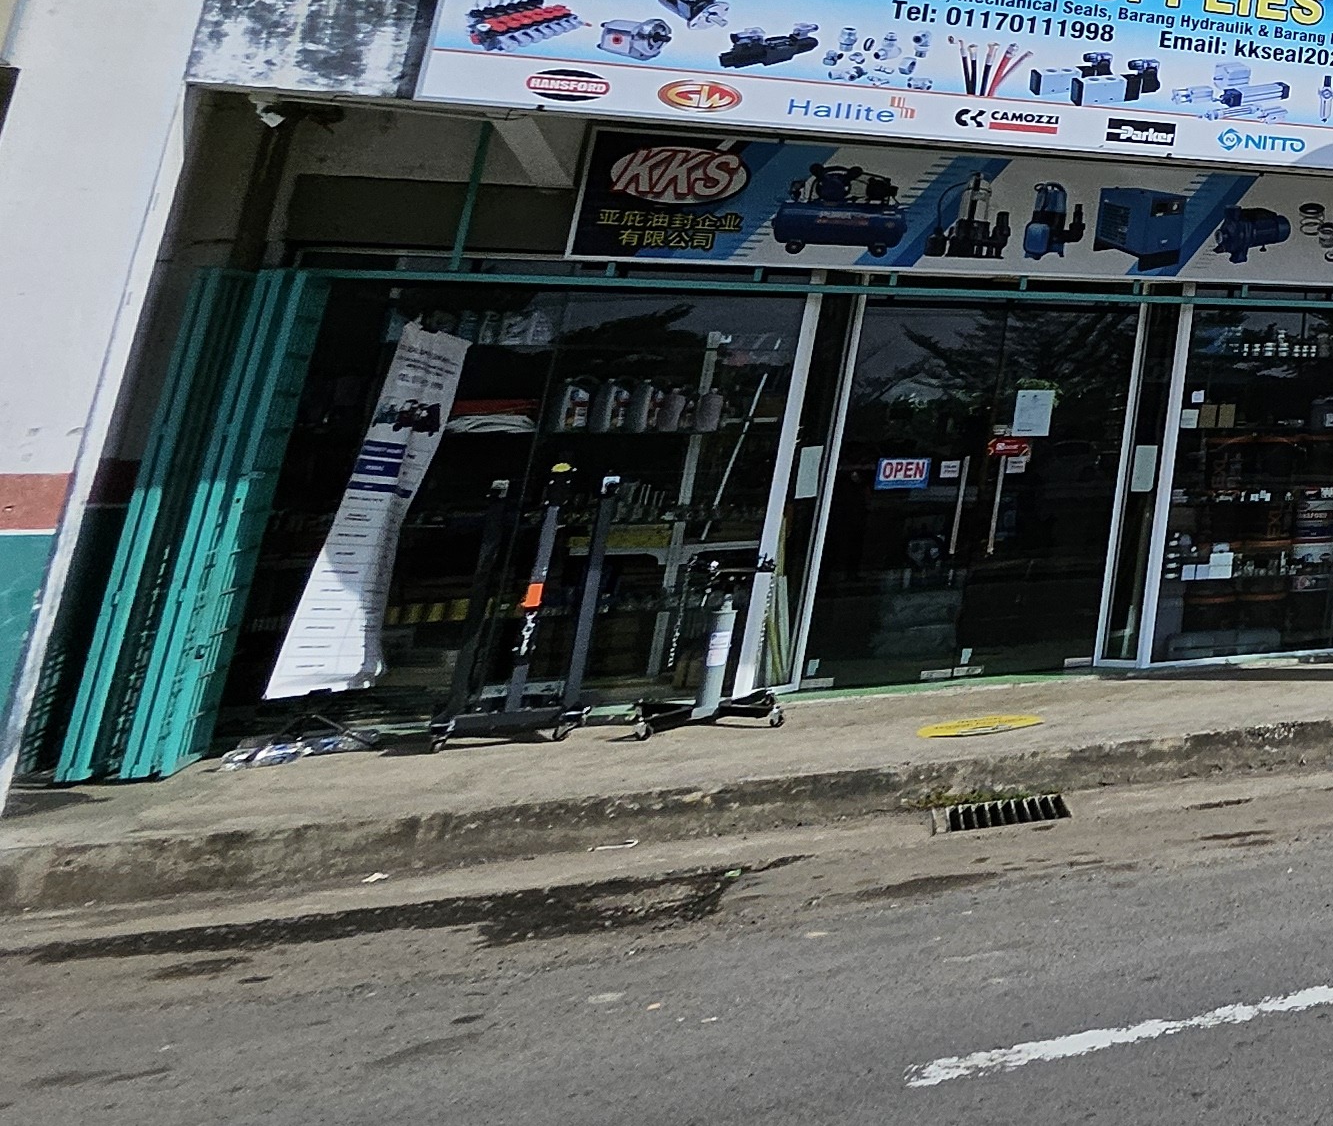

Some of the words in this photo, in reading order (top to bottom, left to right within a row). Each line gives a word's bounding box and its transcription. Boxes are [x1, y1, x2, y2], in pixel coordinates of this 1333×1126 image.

[891, 0, 938, 23] Tel:
[945, 5, 1115, 43] 01170111998
[1158, 30, 1228, 56] Email:
[1062, 0, 1112, 21] Seals,
[1117, 7, 1176, 29] Barang
[1179, 14, 1254, 36] Hydraulik
[1257, 24, 1270, 38] &
[1273, 26, 1325, 46] Barang
[530, 77, 607, 93] HANSFORD
[666, 84, 734, 108] GW
[787, 98, 896, 124] Hallite
[990, 110, 1060, 125] CAMOZZI
[1118, 125, 1175, 143] Parker
[1243, 134, 1306, 153] NITTO
[611, 147, 741, 197] KKS
[597, 208, 743, 231] 亚庇油封企业
[618, 228, 714, 250] 有限公司
[882, 461, 926, 479] OPEN
